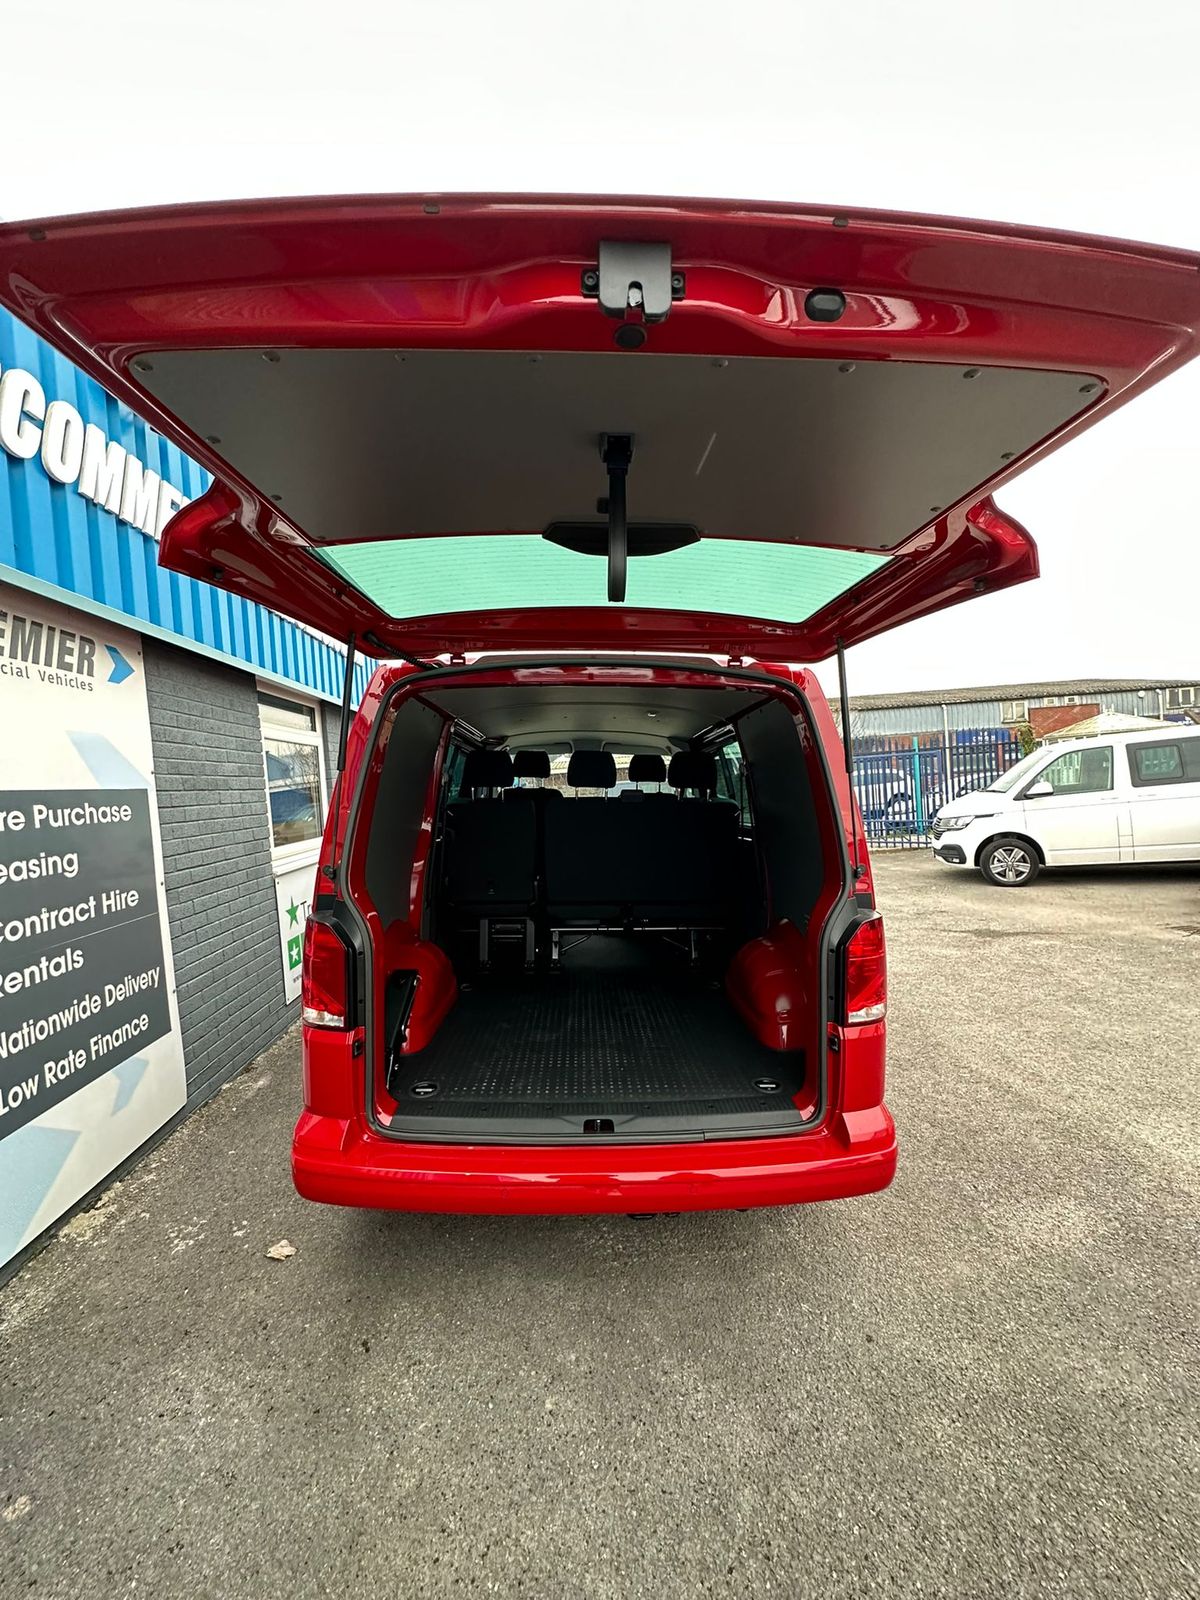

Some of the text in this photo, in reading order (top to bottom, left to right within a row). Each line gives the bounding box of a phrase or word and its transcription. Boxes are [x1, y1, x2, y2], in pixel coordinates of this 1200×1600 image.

[0, 368, 192, 543] COMME
[38, 669, 94, 692] Vehicles
[33, 802, 132, 829] Purchase
[0, 889, 139, 943] ontract Hire
[104, 966, 160, 1008] Delivery
[0, 1013, 149, 1116] Low Rate Finance
